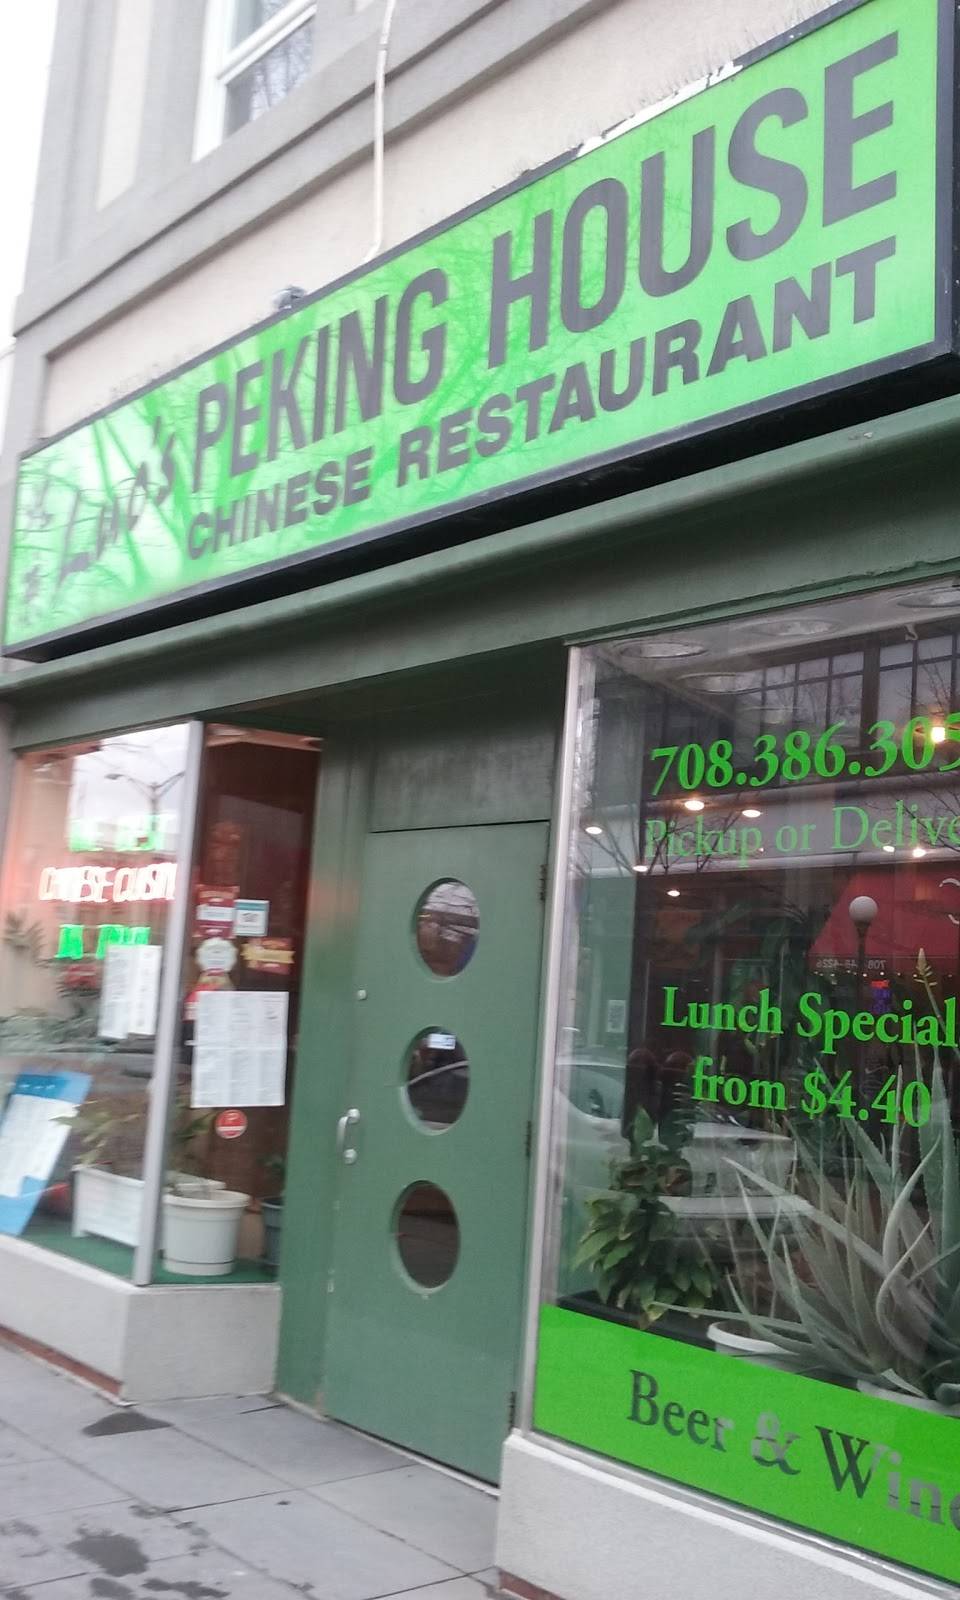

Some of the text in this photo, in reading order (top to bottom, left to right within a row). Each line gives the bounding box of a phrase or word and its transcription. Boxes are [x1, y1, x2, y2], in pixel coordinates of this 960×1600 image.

[192, 267, 448, 493] PEKING
[487, 30, 899, 369] HOUSE
[187, 446, 375, 560] CHINESE
[396, 235, 897, 488] RESTAURANT
[644, 814, 764, 868] Pickup
[775, 822, 817, 852] or
[661, 986, 784, 1035] Lunch
[797, 992, 958, 1055] Special
[692, 1055, 933, 1128] from $4.40
[626, 1368, 735, 1453] Beer
[751, 1410, 802, 1476] &
